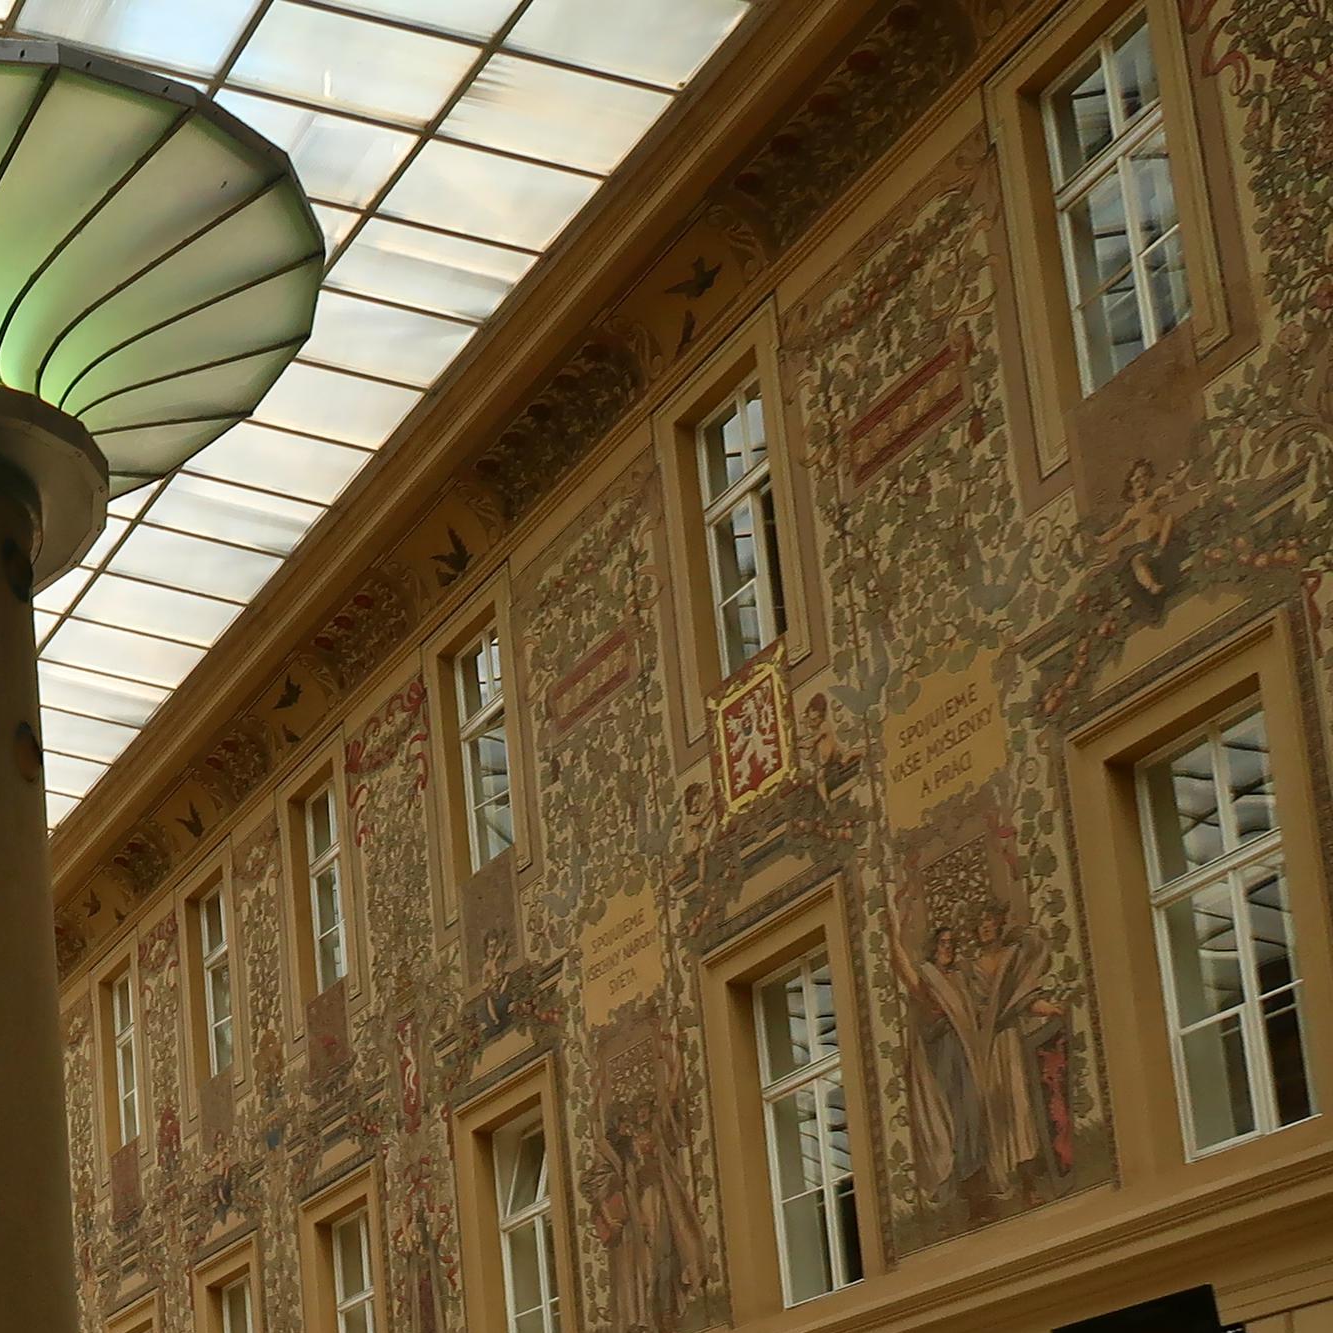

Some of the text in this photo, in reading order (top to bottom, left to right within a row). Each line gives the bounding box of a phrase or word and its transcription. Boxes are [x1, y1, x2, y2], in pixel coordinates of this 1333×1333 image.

[889, 702, 995, 784] VAŠE MYŠLENKY
[898, 681, 978, 749] SPOJUJEME
[920, 778, 932, 799] A
